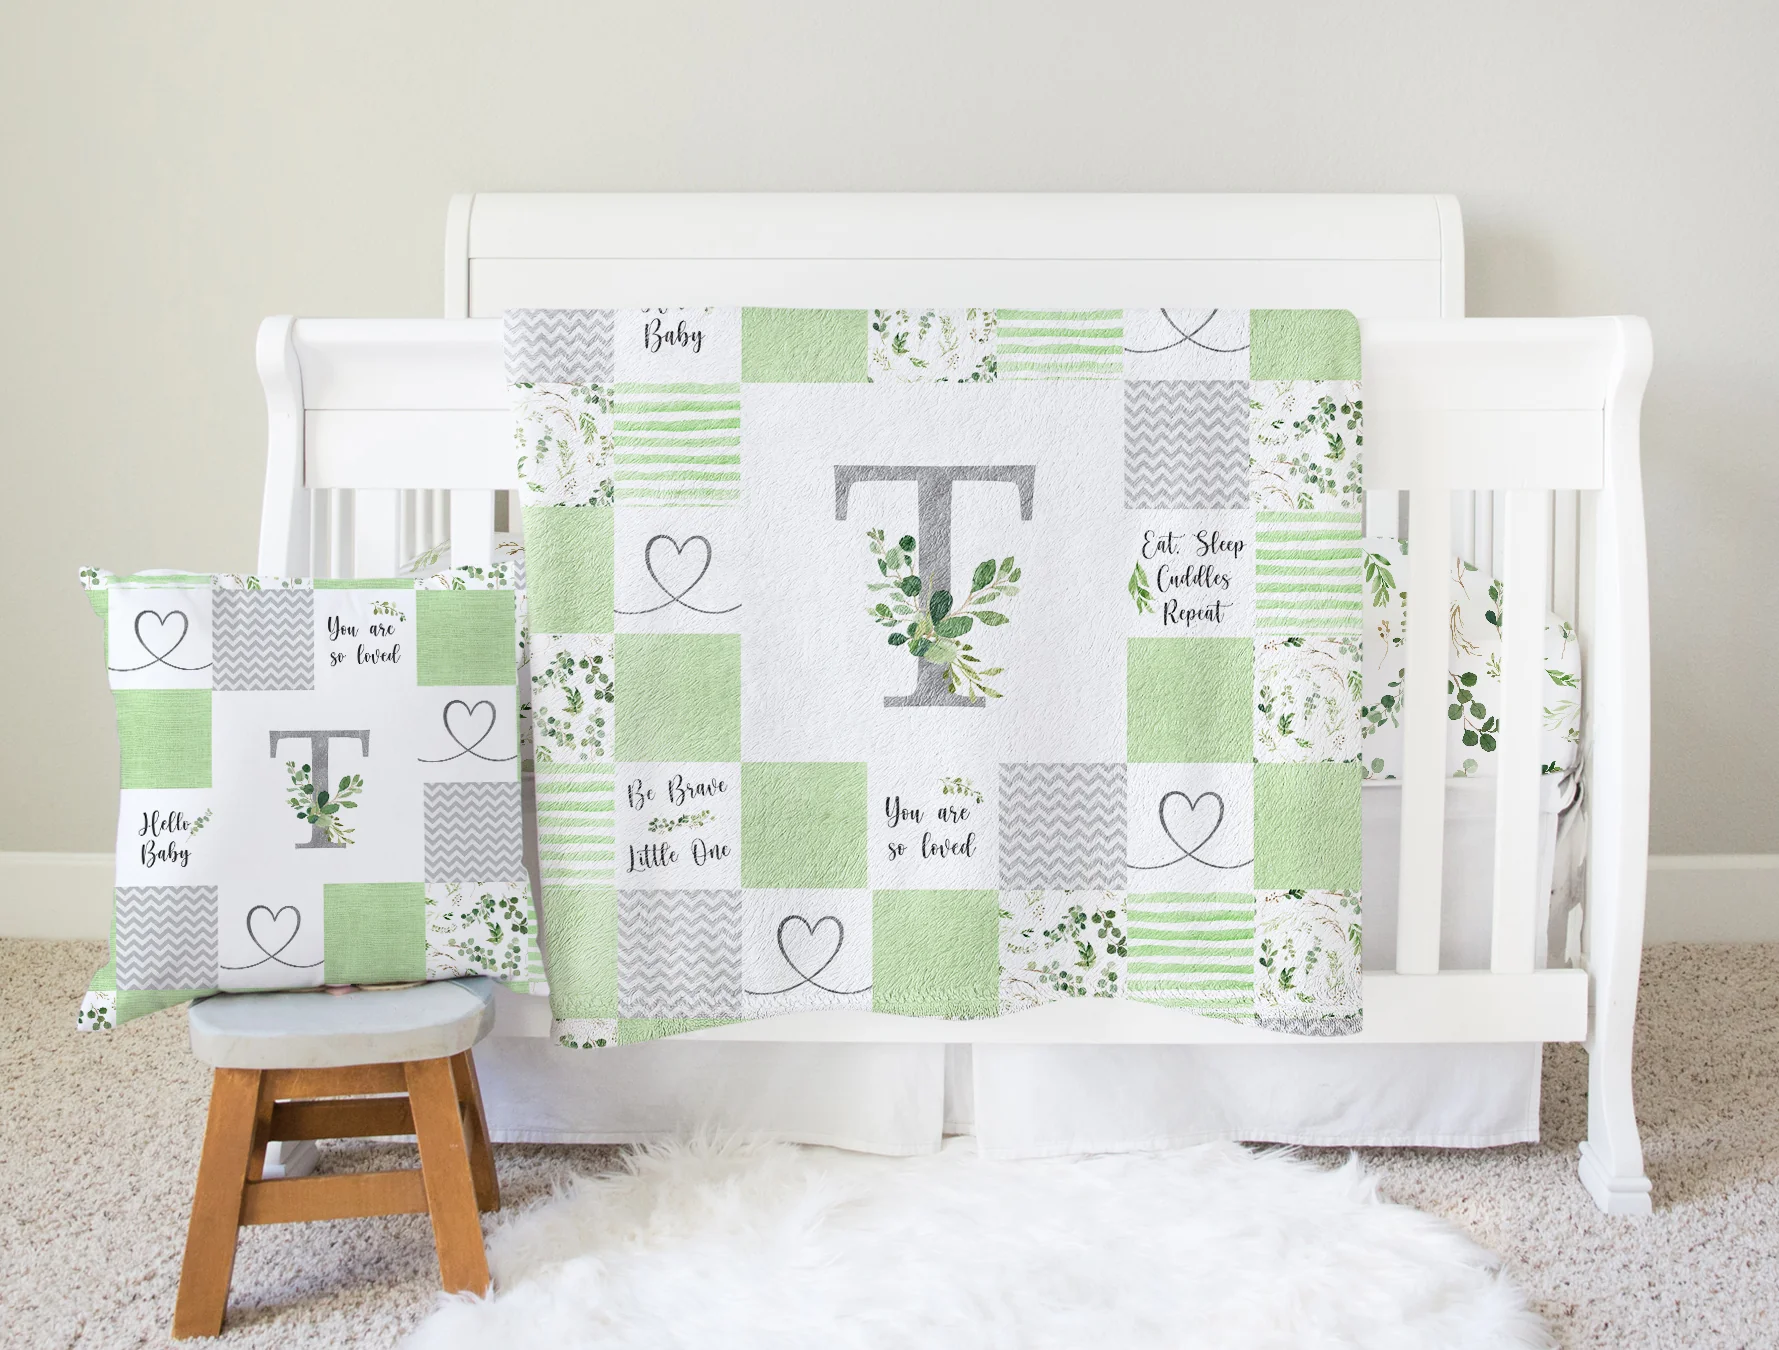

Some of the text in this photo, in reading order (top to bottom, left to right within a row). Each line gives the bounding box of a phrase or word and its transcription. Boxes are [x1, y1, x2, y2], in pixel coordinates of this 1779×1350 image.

[644, 318, 706, 353] Baby
[1192, 529, 1247, 559] Sleep
[833, 465, 1037, 708] T
[1157, 564, 1232, 592] Cuddles
[1163, 599, 1233, 627] Repeat
[327, 615, 395, 641] You are
[330, 643, 401, 667] so loved
[268, 729, 371, 849] T
[627, 774, 728, 811] Be Brave
[138, 810, 191, 837] Hello
[885, 796, 970, 828] You are
[141, 839, 192, 868] Baby
[626, 838, 731, 873] Little One
[888, 832, 976, 861] so loved
